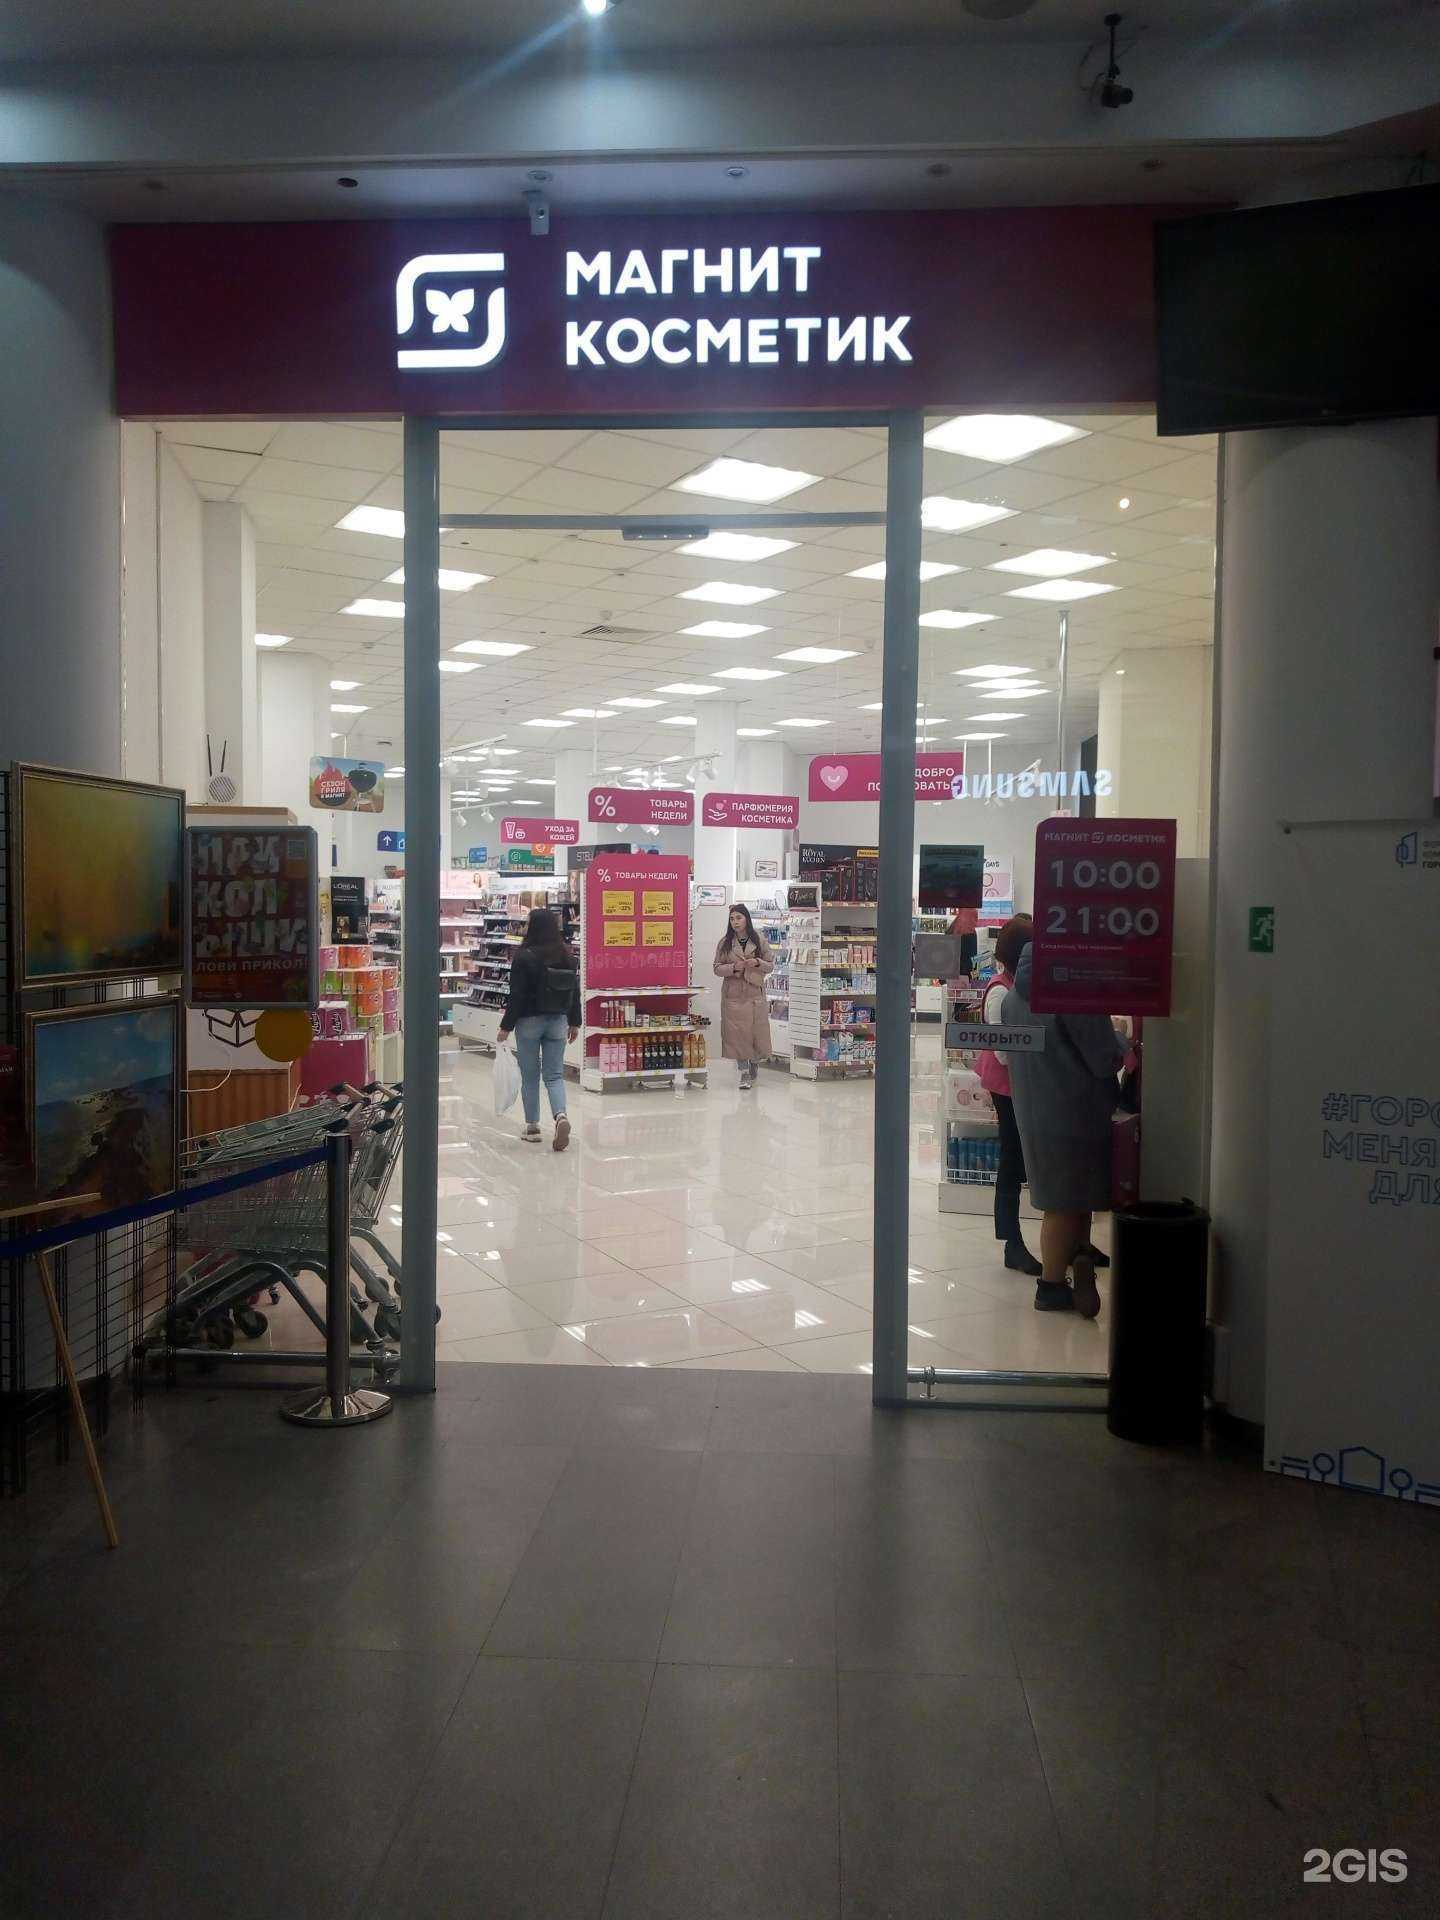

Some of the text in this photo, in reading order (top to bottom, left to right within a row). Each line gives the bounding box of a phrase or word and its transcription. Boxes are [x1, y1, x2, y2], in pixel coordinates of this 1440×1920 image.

[565, 246, 822, 297] МАГНИТ
[565, 316, 914, 367] КОСМЕТИК
[914, 767, 955, 778] ДОБРО
[649, 798, 688, 809] ТОВАРЫ
[731, 802, 793, 814] ПАРФЮМЕРИЯ
[650, 810, 688, 821] НЕДЕЛИ
[741, 814, 794, 825] КОСМЕТИКА
[544, 825, 576, 834] УХОД ЗА
[549, 832, 576, 842] КОЖЕЙ
[1044, 831, 1168, 845] МАГНИТ КОСМЕТИК
[615, 871, 648, 880] ТОВАРЫ
[648, 872, 679, 881] НЕДЕЛИ
[1051, 859, 1161, 890] 10:00
[1045, 906, 1160, 937] 21:00
[195, 960, 237, 972] ЛОВИ
[959, 1030, 1033, 1047] открыто
[1320, 1092, 1440, 1129] #ГОР
